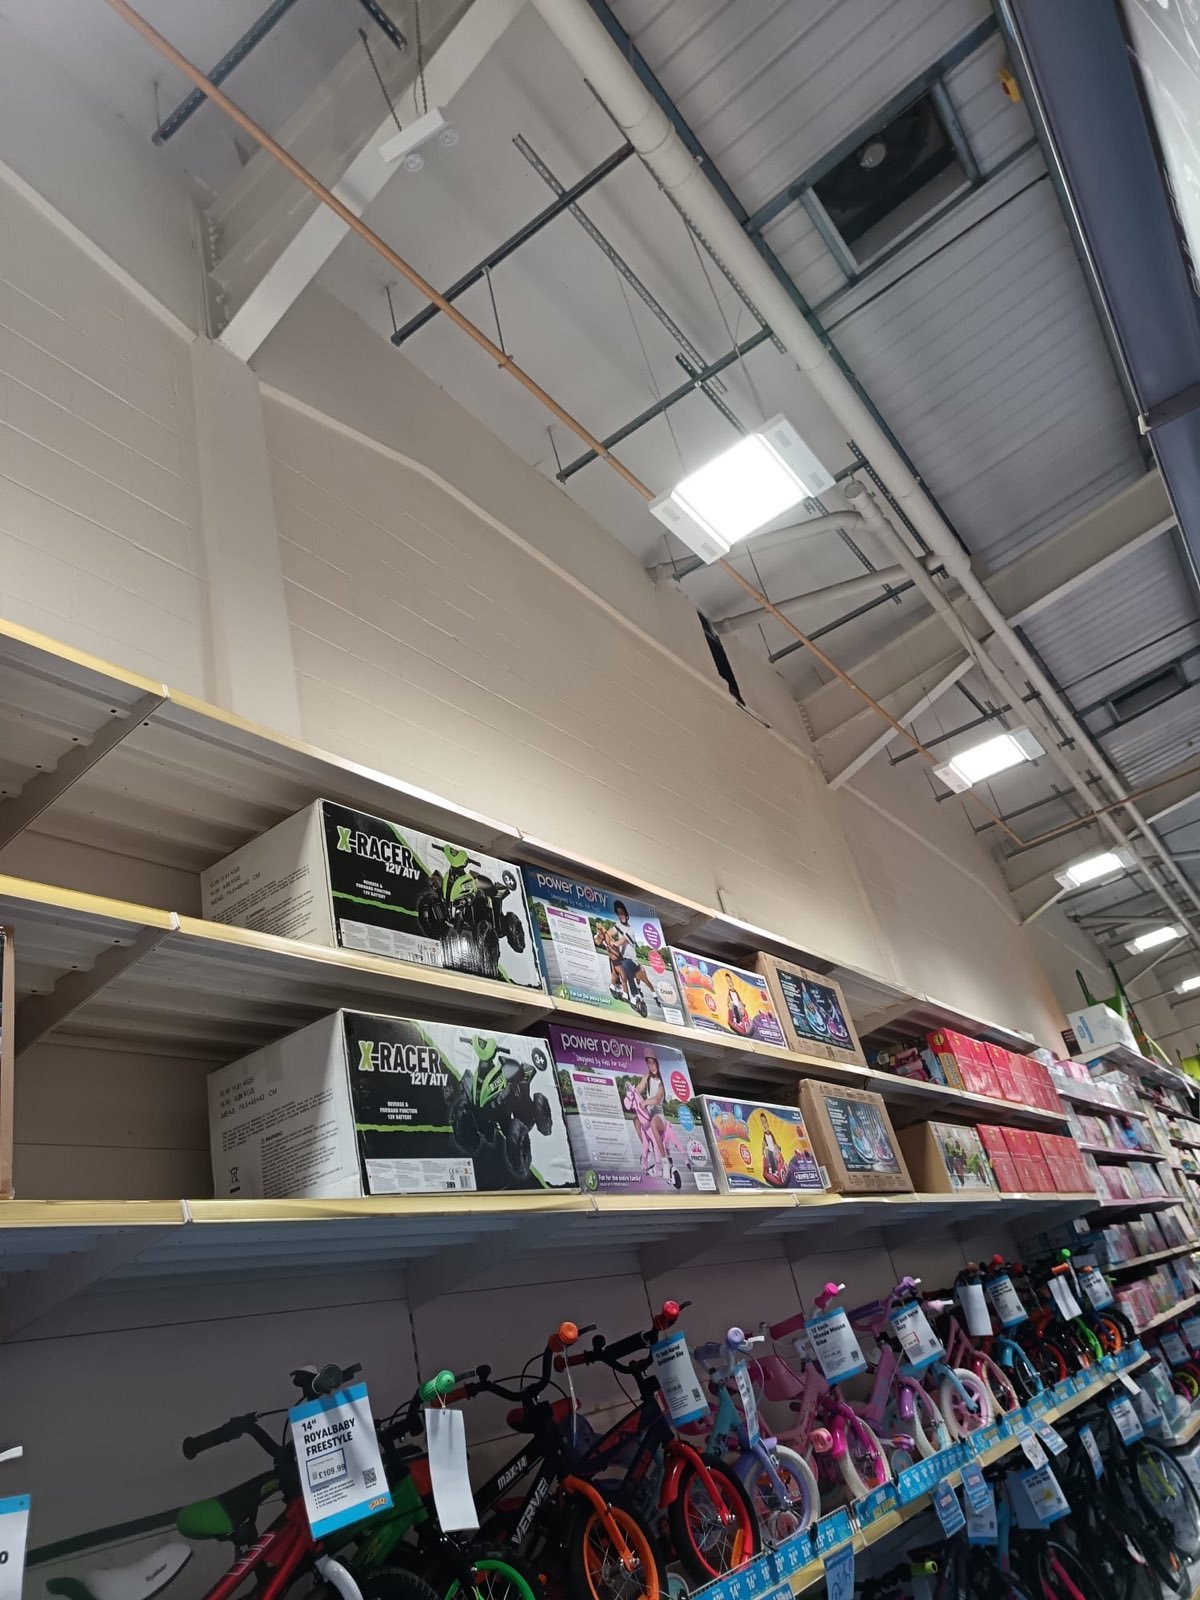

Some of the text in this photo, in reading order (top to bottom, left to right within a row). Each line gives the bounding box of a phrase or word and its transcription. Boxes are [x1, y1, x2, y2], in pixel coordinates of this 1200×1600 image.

[336, 825, 414, 868] X-RACER
[385, 862, 421, 880] 12V ATV
[504, 874, 515, 886] 3+
[536, 873, 608, 907] power pony
[560, 1032, 633, 1061] power pony
[358, 1040, 441, 1075] X-RACER
[534, 1053, 545, 1065] 3+
[410, 1071, 448, 1087] 12V ATV
[268, 1088, 278, 1097] CM
[830, 1323, 846, 1333] Mouse
[301, 1419, 317, 1433] 14"
[303, 1417, 356, 1445] ROYALBABY
[305, 1431, 353, 1457] FREESTYLE
[318, 1463, 346, 1479] £109.99
[511, 1477, 549, 1544] VERVE
